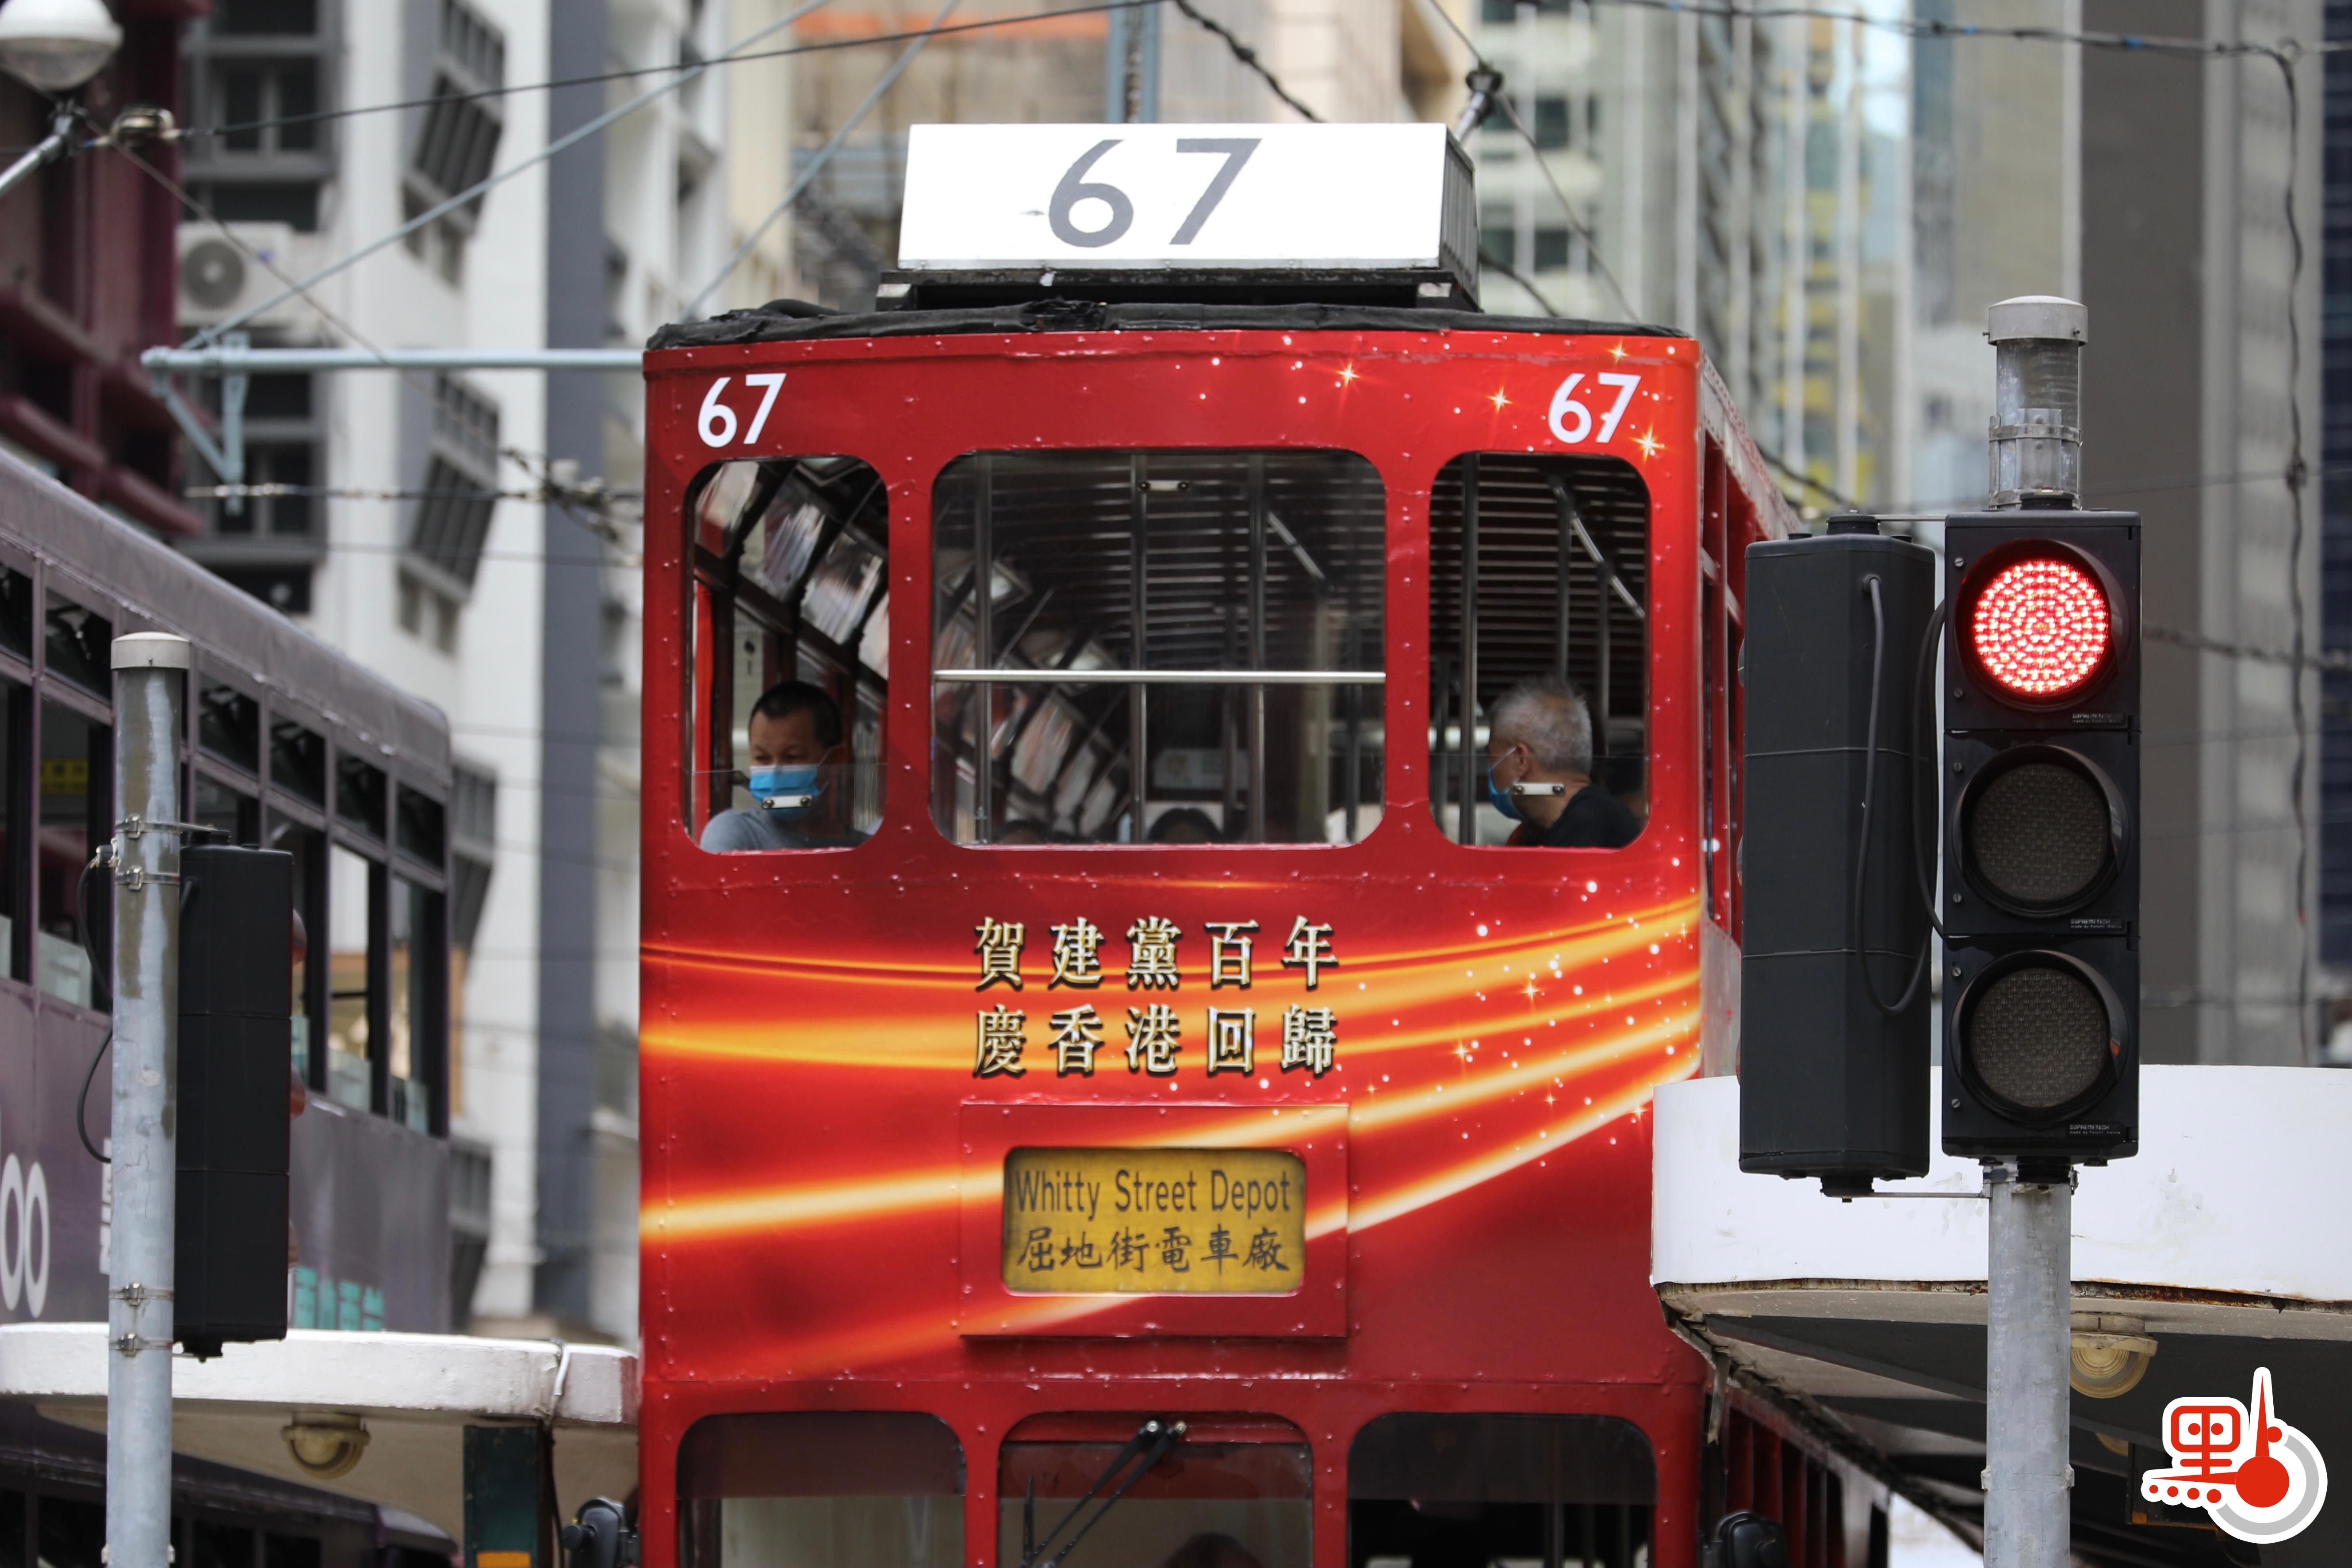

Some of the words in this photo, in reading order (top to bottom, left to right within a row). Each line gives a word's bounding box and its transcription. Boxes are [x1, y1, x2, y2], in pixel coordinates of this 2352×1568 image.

[1048, 138, 1262, 248] 67
[697, 373, 786, 448] 67
[1548, 372, 1641, 445] 67
[975, 915, 1339, 990] 賀建黨百年
[975, 1003, 1337, 1075] 慶香港回歸
[1017, 1171, 1100, 1221] Whitty
[1115, 1169, 1197, 1212] Street
[1211, 1170, 1290, 1219] Depot
[1018, 1224, 1290, 1276] 屈地街電車廠
